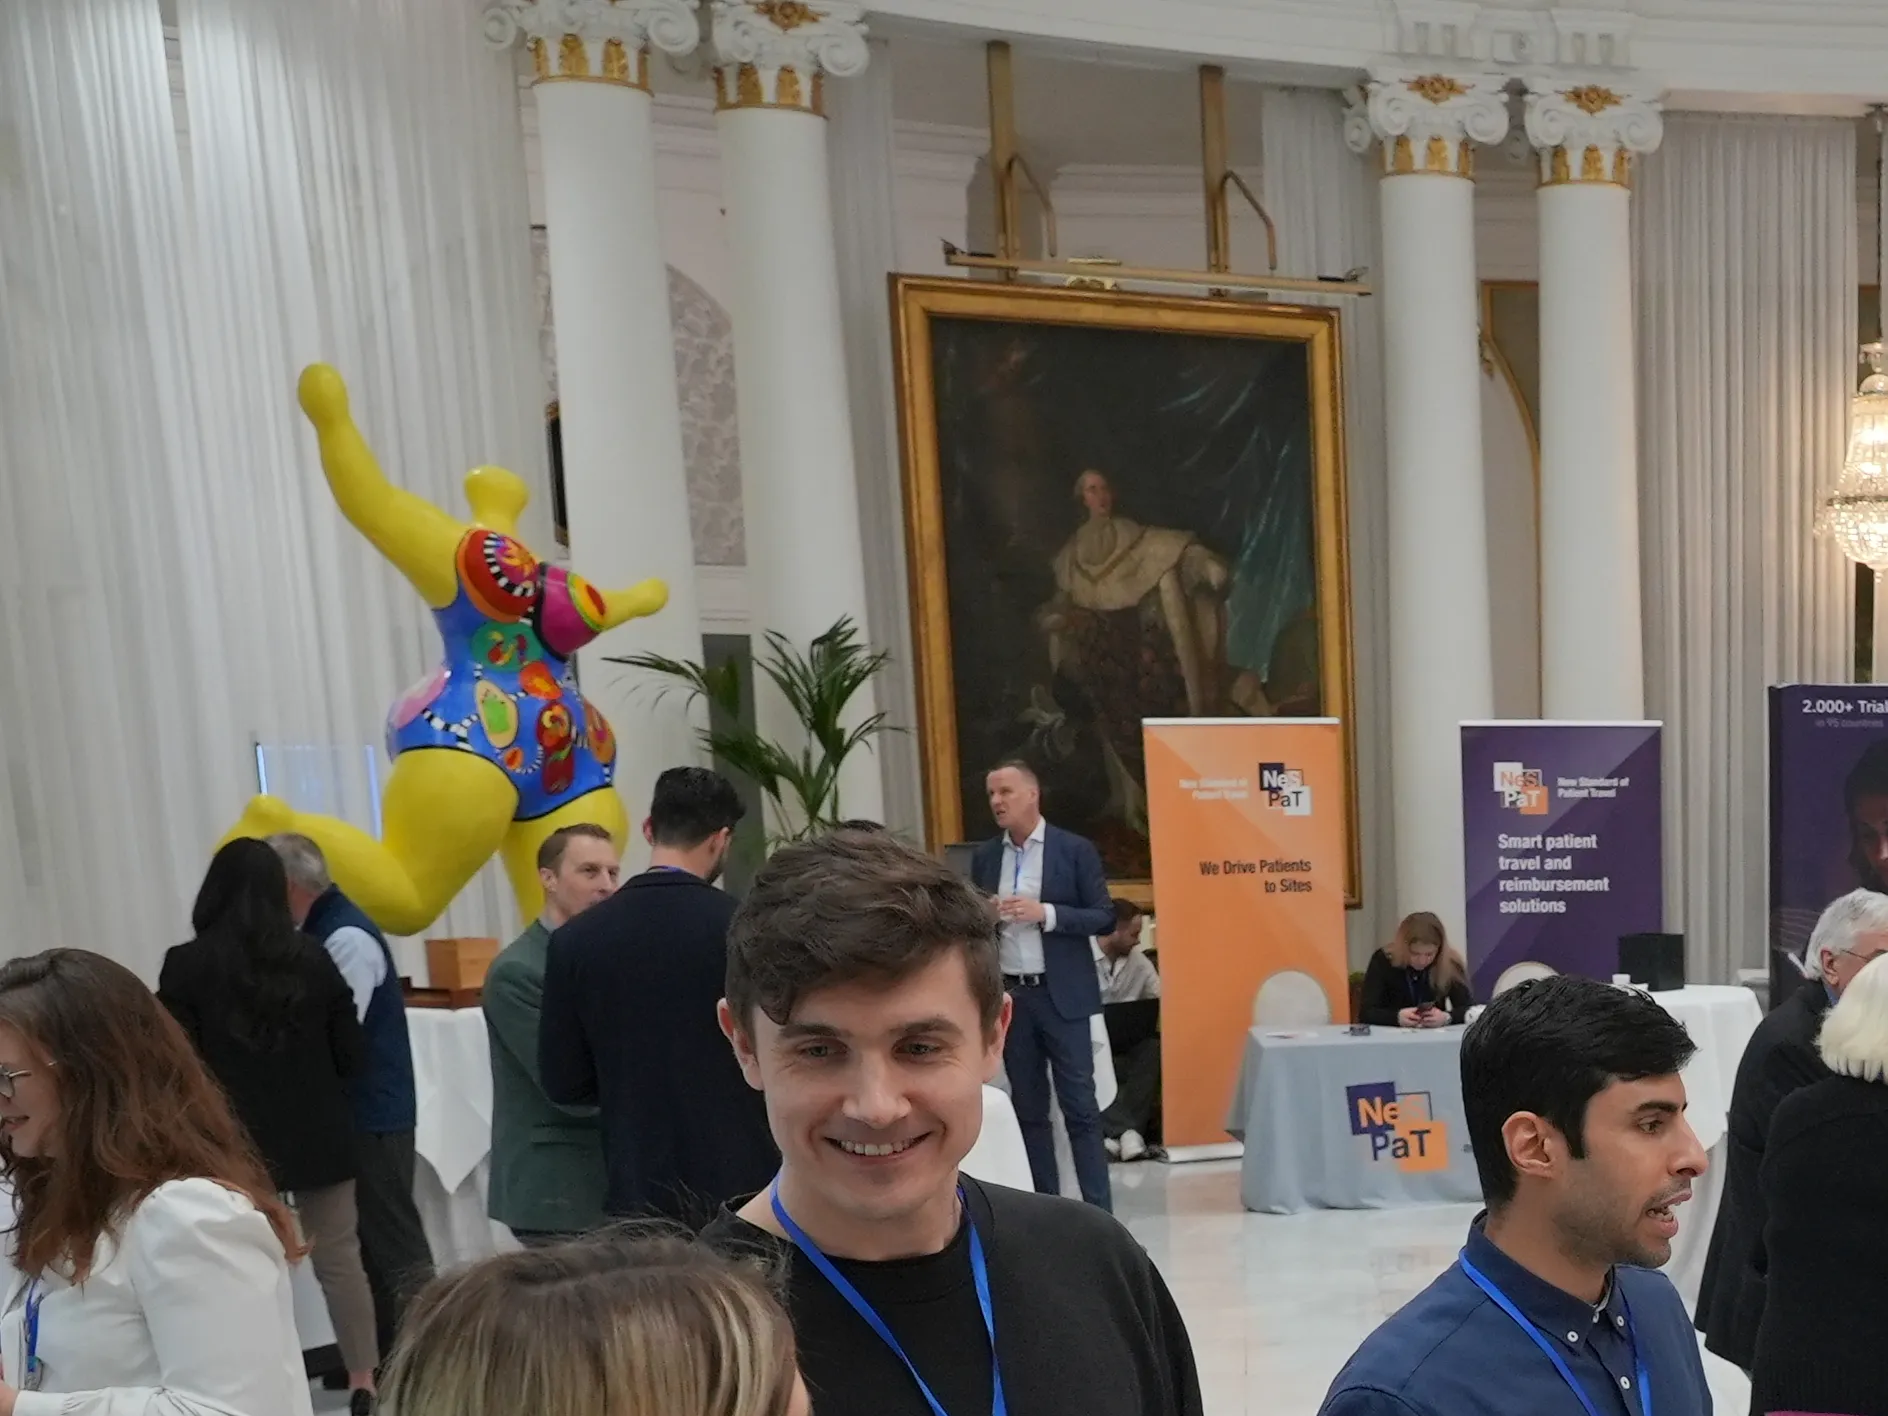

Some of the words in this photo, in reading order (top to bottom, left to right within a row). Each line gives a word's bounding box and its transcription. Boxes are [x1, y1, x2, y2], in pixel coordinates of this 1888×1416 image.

[1802, 699, 1853, 713] 2.000+
[1268, 790, 1302, 808] PaT
[1504, 789, 1541, 808] PaT
[1498, 833, 1543, 849] Smart
[1545, 833, 1598, 851] patient
[1199, 860, 1219, 876] We
[1223, 860, 1256, 875] Drive
[1259, 858, 1312, 874] Patients
[1499, 855, 1540, 870] travel
[1543, 855, 1572, 870] and
[1264, 880, 1277, 893] to
[1280, 878, 1312, 893] Sites
[1499, 876, 1610, 892] reimbursement
[1500, 899, 1566, 914] solutions
[1371, 1128, 1431, 1162] PaT
